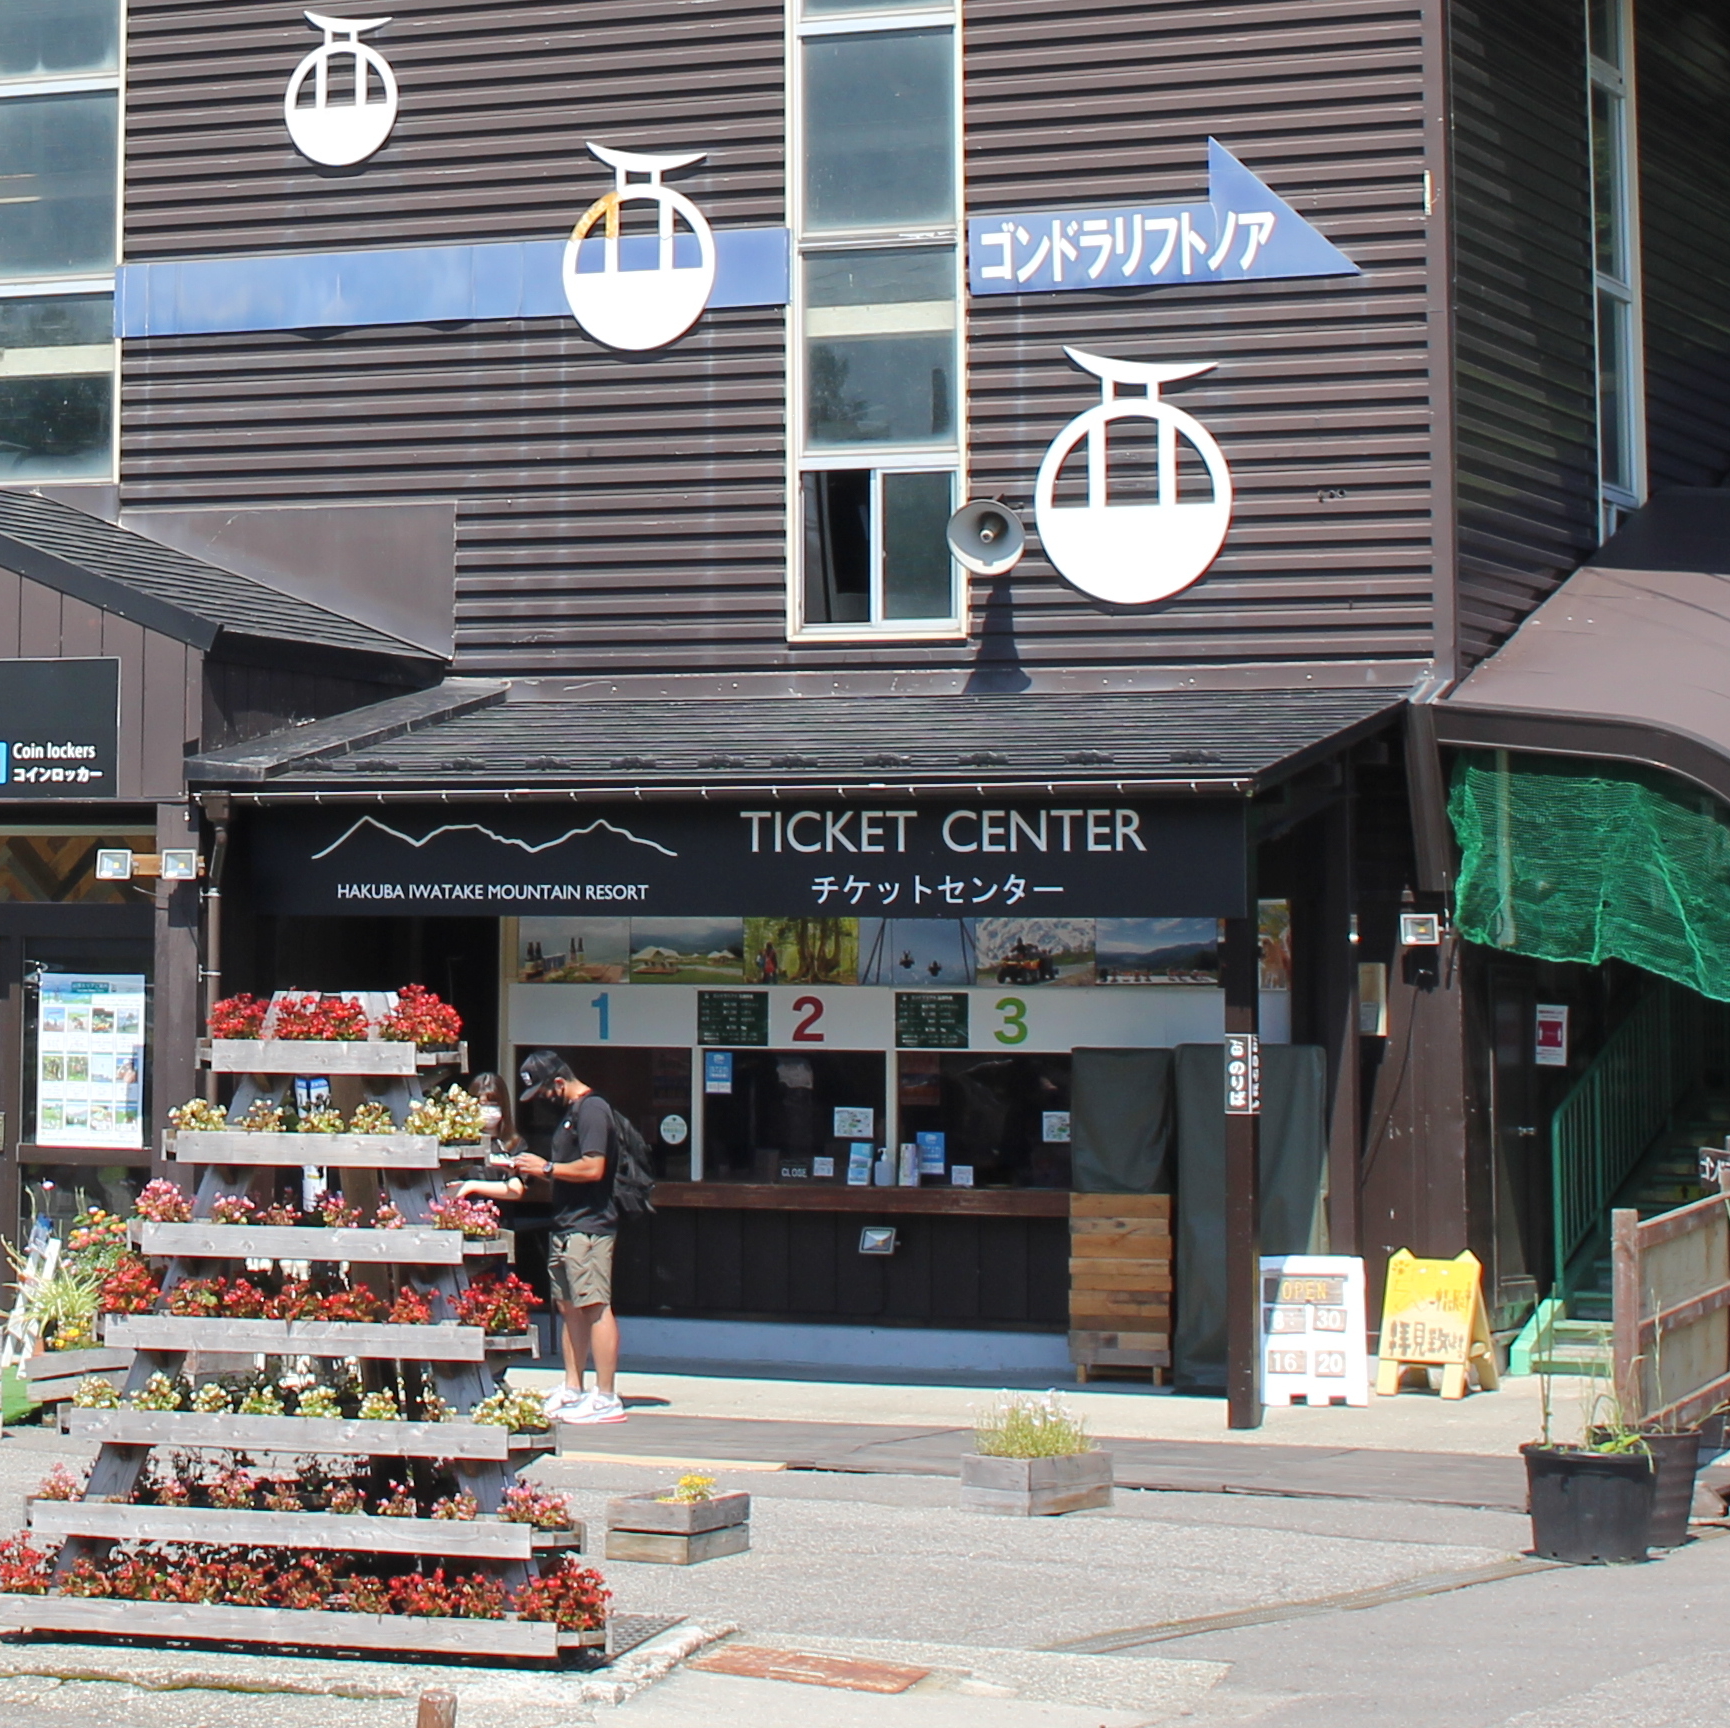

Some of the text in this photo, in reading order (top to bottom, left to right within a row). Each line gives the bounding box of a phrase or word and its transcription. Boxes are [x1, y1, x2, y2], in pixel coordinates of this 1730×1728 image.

[980, 210, 1275, 283] ゴンドラリフトノア
[13, 742, 96, 759] Coin lockers
[13, 767, 103, 783] コインロッカー
[740, 808, 1147, 853] TICKET CENTER
[337, 884, 649, 900] HAKUBA IWATAKE MOUNTAIN RESORT
[811, 874, 1064, 905] チケットセンター
[592, 993, 610, 1040] 1
[792, 996, 824, 1041] 2
[993, 997, 1028, 1045] 3
[781, 1168, 807, 1178] CLOSE
[1282, 1281, 1328, 1300] OPEN
[1317, 1309, 1341, 1325] 30
[1273, 1354, 1298, 1371] 16
[1319, 1354, 1343, 1372] 20
